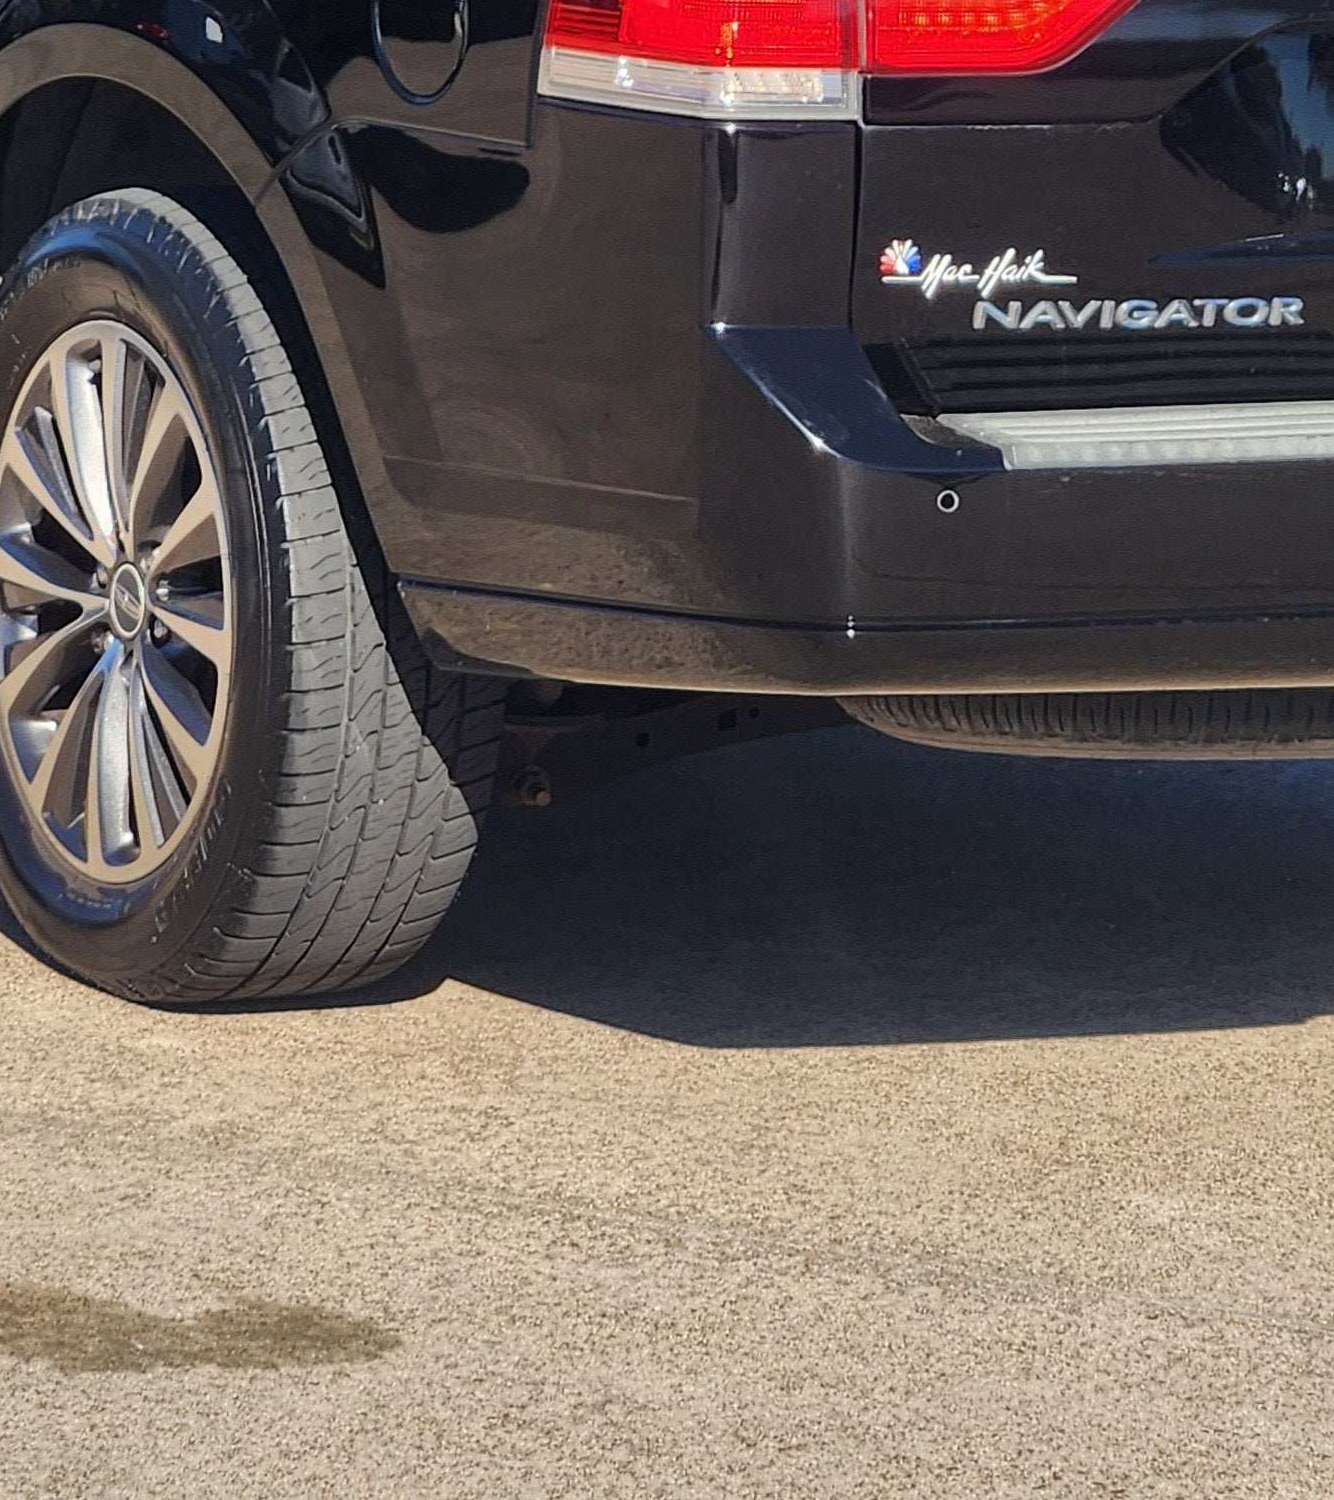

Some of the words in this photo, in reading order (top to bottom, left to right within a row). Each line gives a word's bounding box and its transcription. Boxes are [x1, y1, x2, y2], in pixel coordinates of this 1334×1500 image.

[919, 253, 978, 300] Mac
[975, 246, 1053, 299] Haik
[972, 297, 1305, 330] NAVIGATOR
